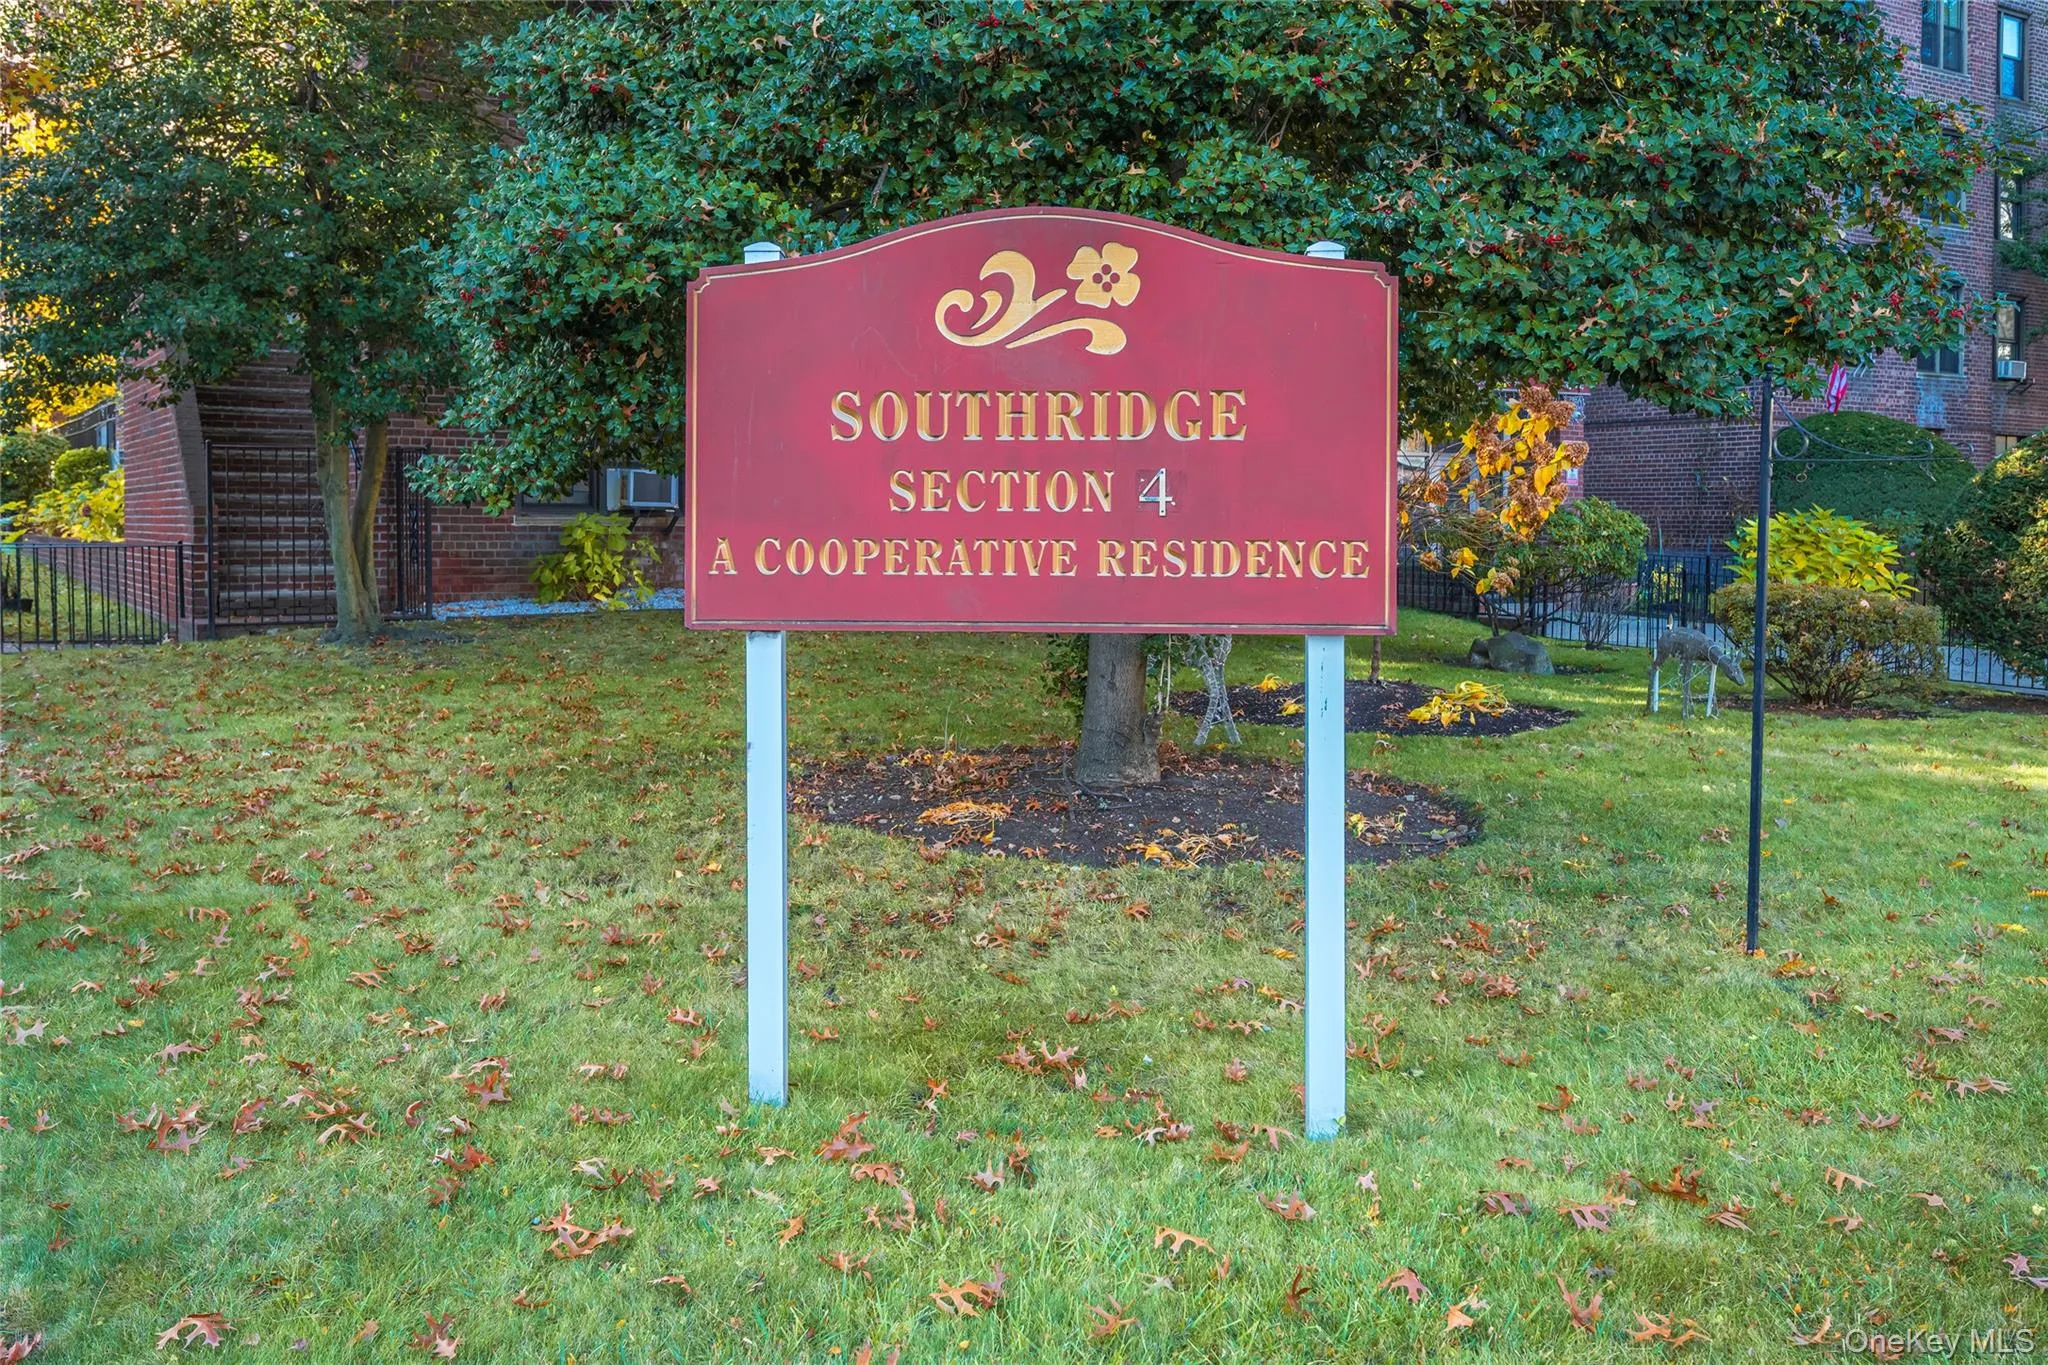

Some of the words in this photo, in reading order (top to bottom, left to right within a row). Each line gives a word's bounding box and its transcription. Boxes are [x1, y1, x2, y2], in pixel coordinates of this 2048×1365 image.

[830, 389, 1248, 443] SOUTHRIDGE
[888, 469, 1115, 513] SECTION
[1139, 467, 1174, 517] 4
[708, 537, 738, 576] A
[754, 537, 1078, 577] COOPERATIVE
[1097, 538, 1370, 580] RESIDENCE
